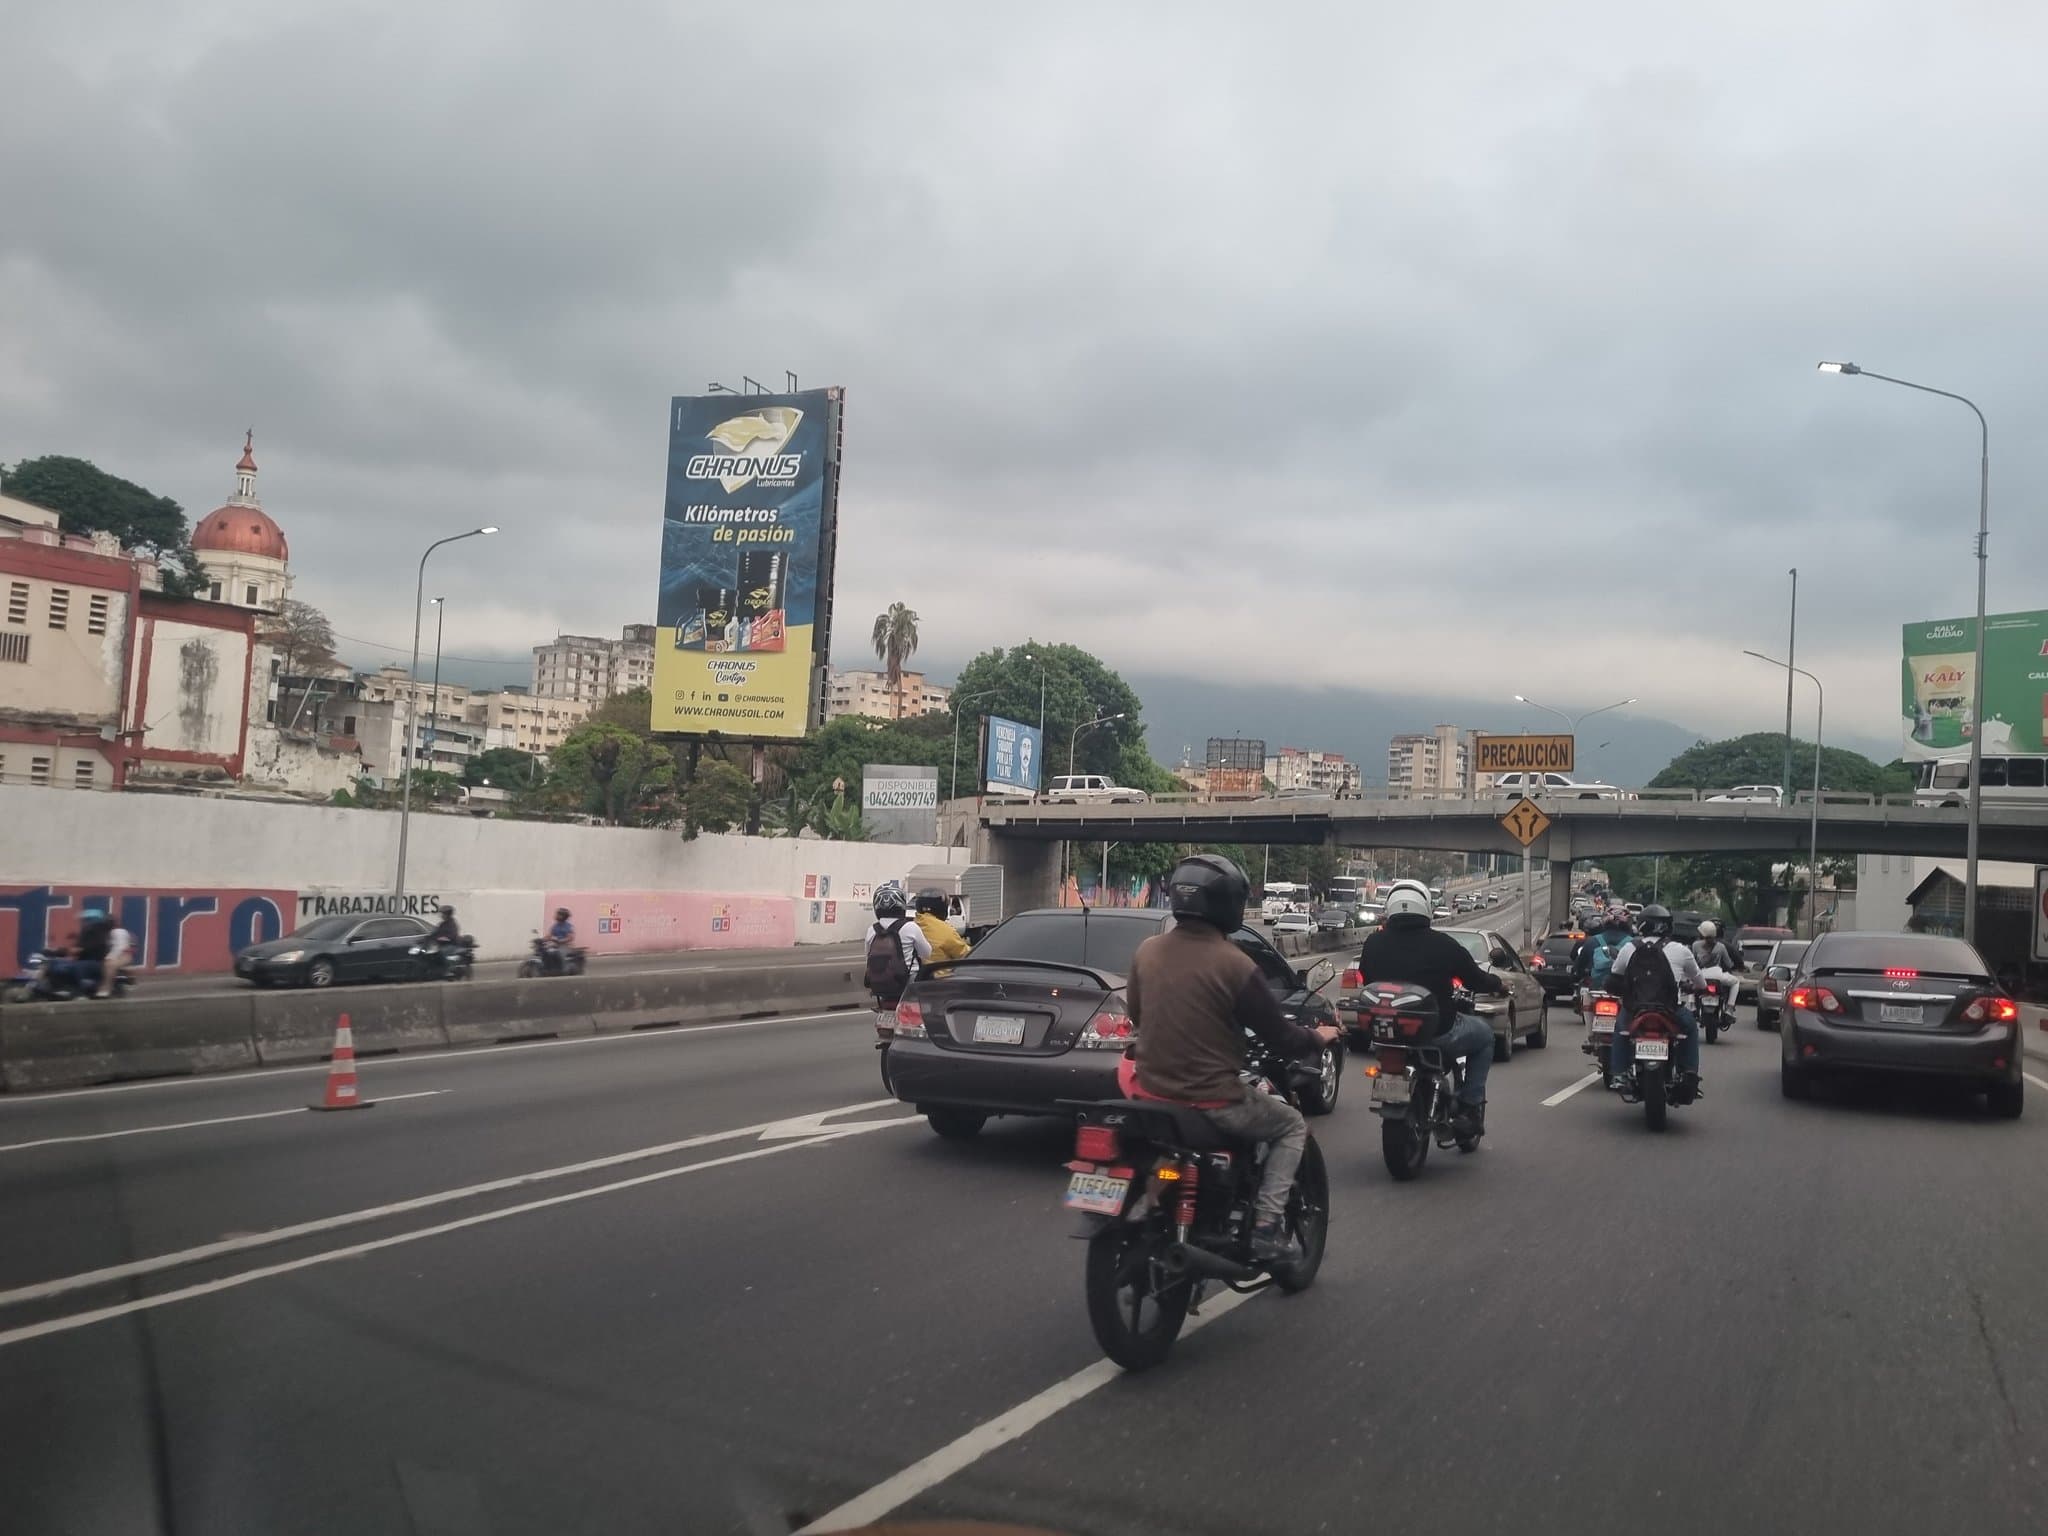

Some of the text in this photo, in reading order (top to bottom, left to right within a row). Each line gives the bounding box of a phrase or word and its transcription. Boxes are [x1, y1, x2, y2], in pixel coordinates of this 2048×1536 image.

[686, 454, 801, 479] CHRONUS
[756, 479, 795, 487] Lubricantes
[685, 505, 777, 522] Kilómetros
[713, 525, 794, 545] de pasión
[1926, 630, 1964, 639] CALIDAD
[1935, 624, 1956, 633] KALY
[707, 661, 756, 671] CHRONUS
[715, 671, 746, 685] Contigo
[1924, 671, 1966, 683] KALY
[674, 706, 784, 719] WWW.CHRONUSOIL.COM
[1482, 739, 1568, 766] PRECAUCIÓN
[877, 781, 937, 791] DISPONIBLE
[870, 792, 936, 806] 04242399749
[298, 895, 440, 916] TRABAJADORES
